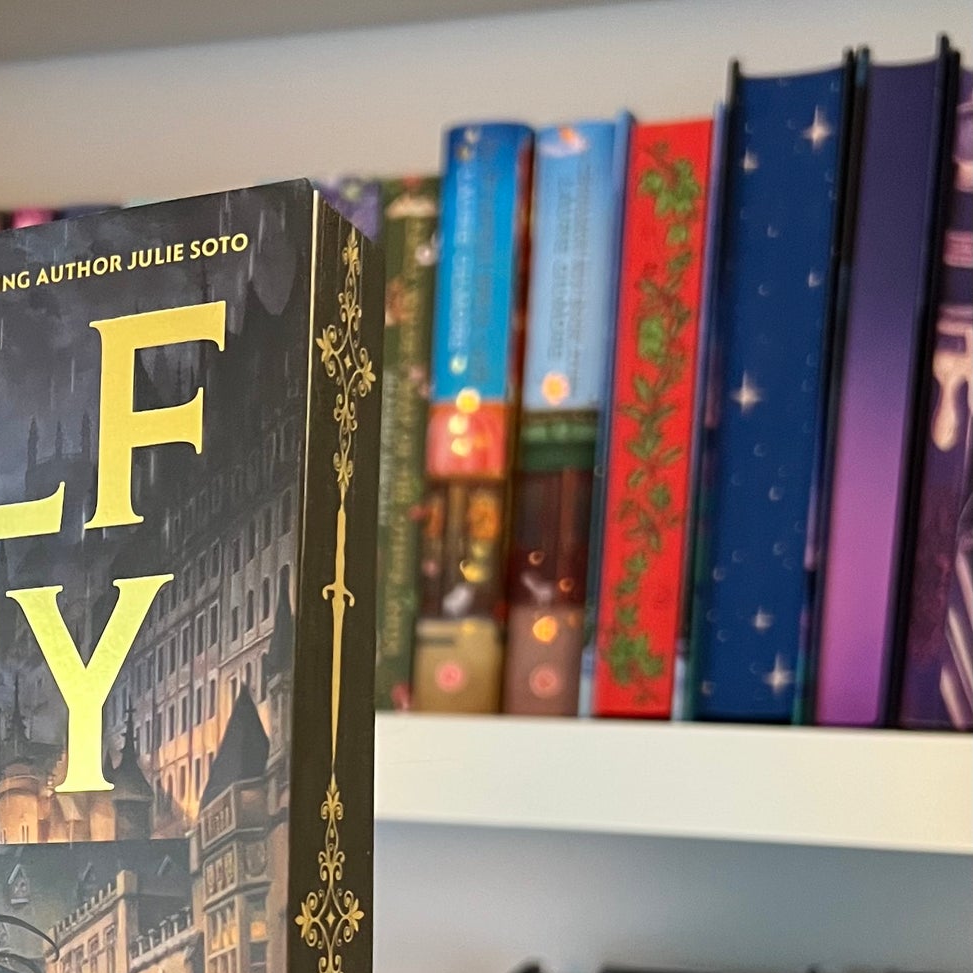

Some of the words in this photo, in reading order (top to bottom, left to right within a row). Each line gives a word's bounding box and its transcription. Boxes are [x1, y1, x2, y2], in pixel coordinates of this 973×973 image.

[35, 254, 123, 286] AUTHOR
[126, 243, 184, 271] JULIE
[189, 232, 249, 260] SOTO
